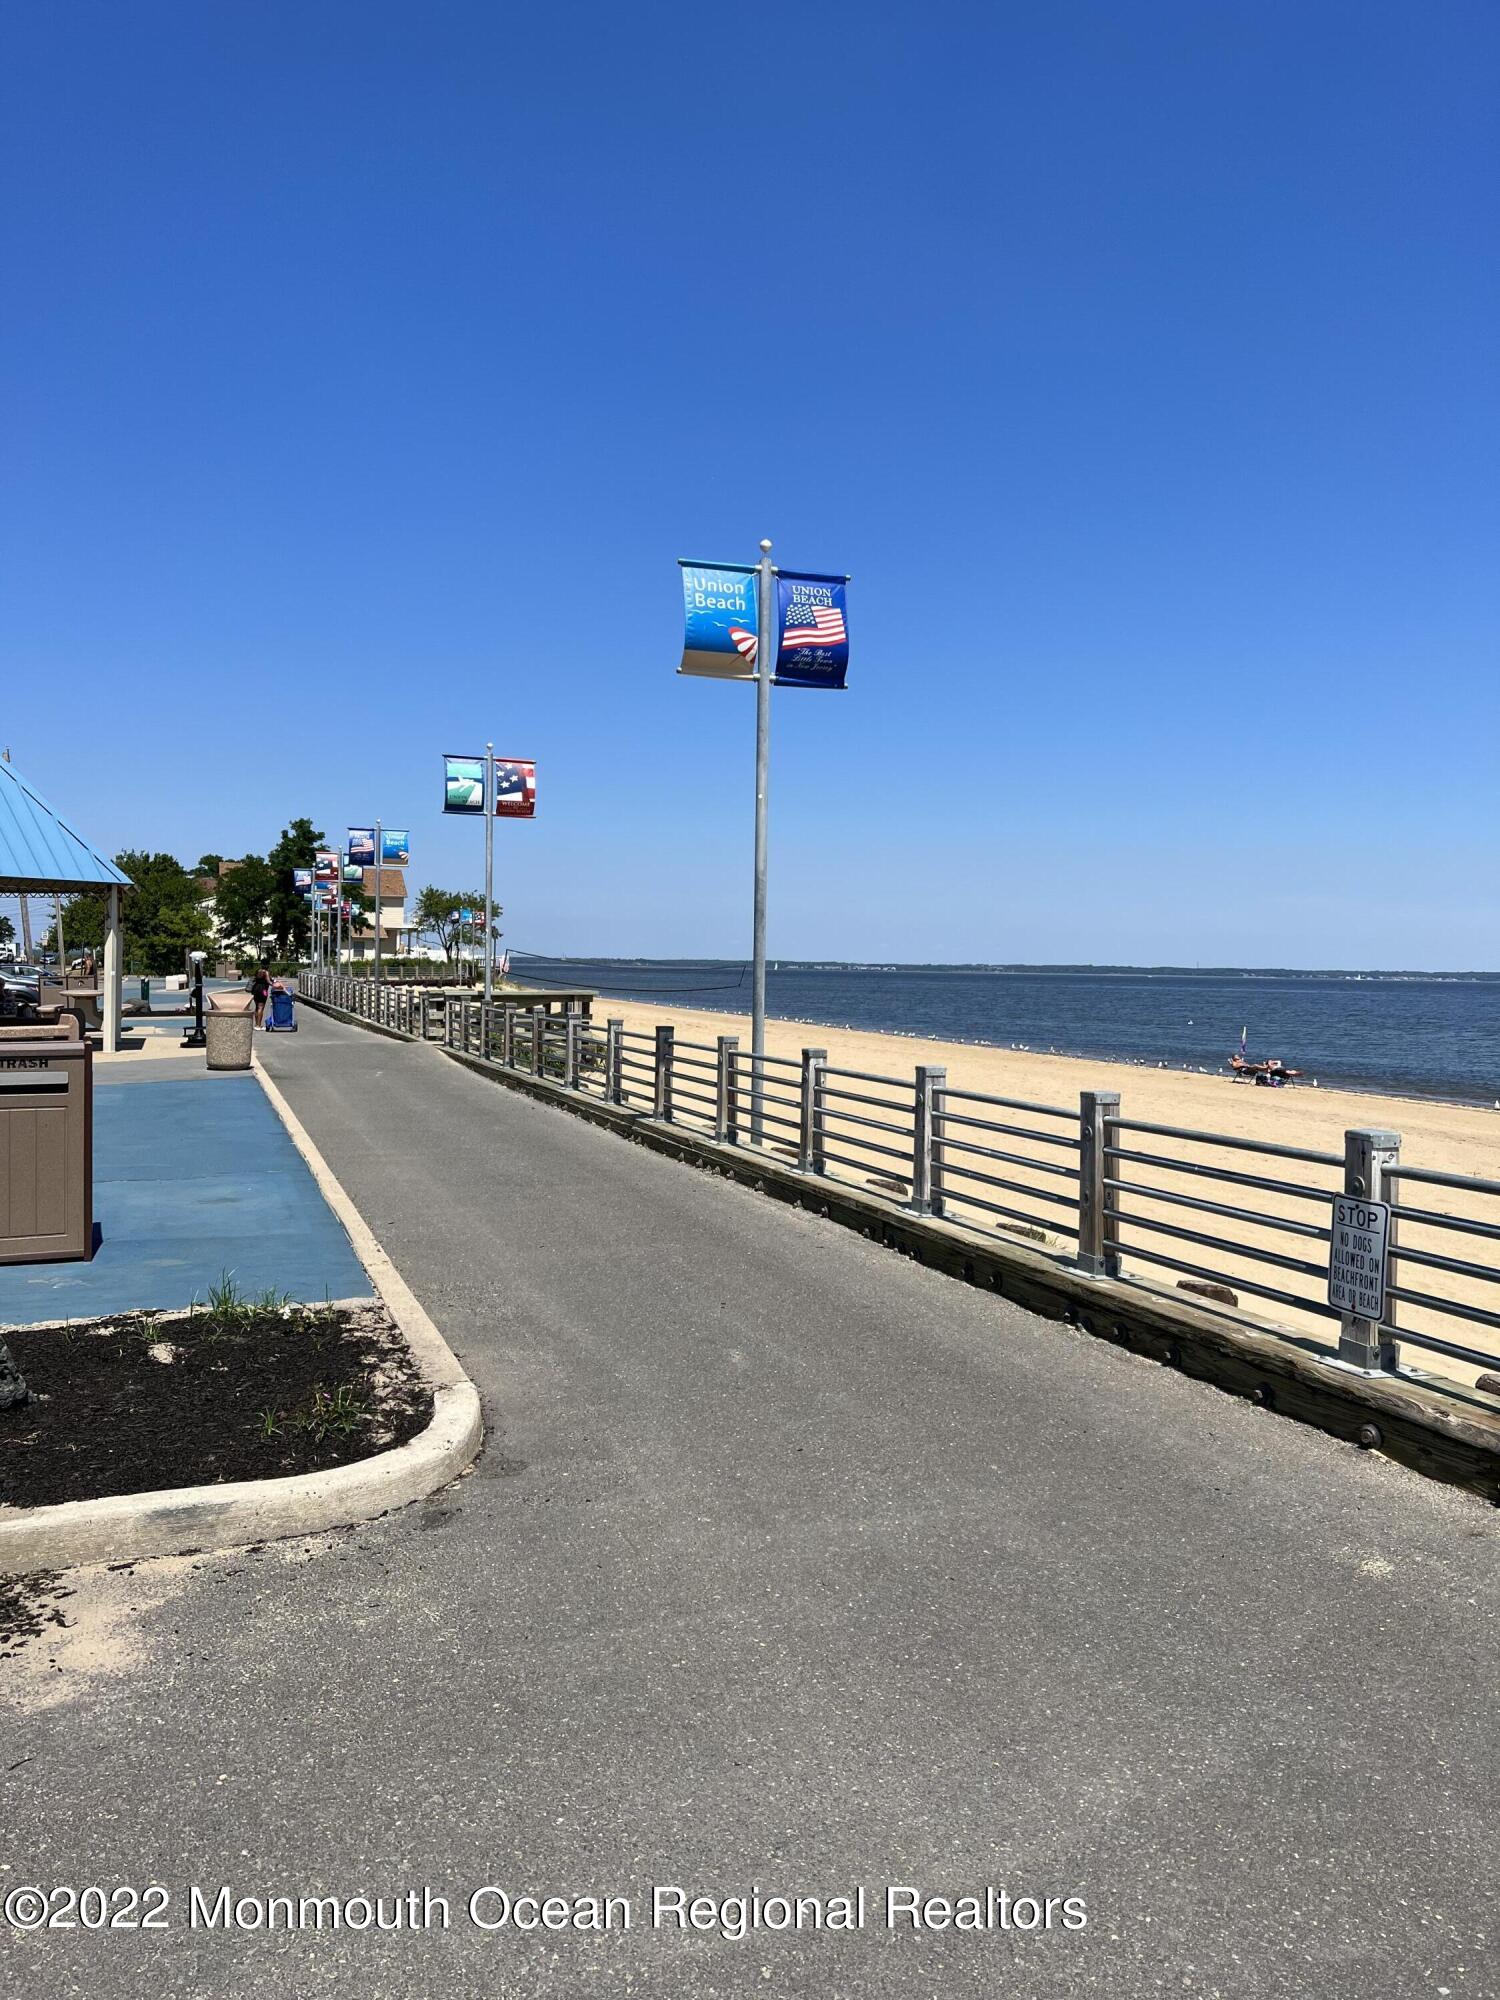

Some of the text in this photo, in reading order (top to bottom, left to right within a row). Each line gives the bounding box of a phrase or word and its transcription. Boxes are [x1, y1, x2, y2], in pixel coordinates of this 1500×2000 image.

[694, 577, 744, 594] Union
[791, 585, 832, 597] UNION
[695, 593, 746, 611] Beach
[793, 594, 833, 607] BEACH
[813, 648, 832, 657] Best
[0, 1058, 49, 1069] TRASH
[1337, 1204, 1378, 1229] STOP
[1340, 1231, 1372, 1254] NO DOGS
[1334, 1247, 1380, 1274] ALLOWED ON
[1333, 1265, 1379, 1293] BEACHFRONT
[1332, 1283, 1379, 1312] AREA OR BEACH
